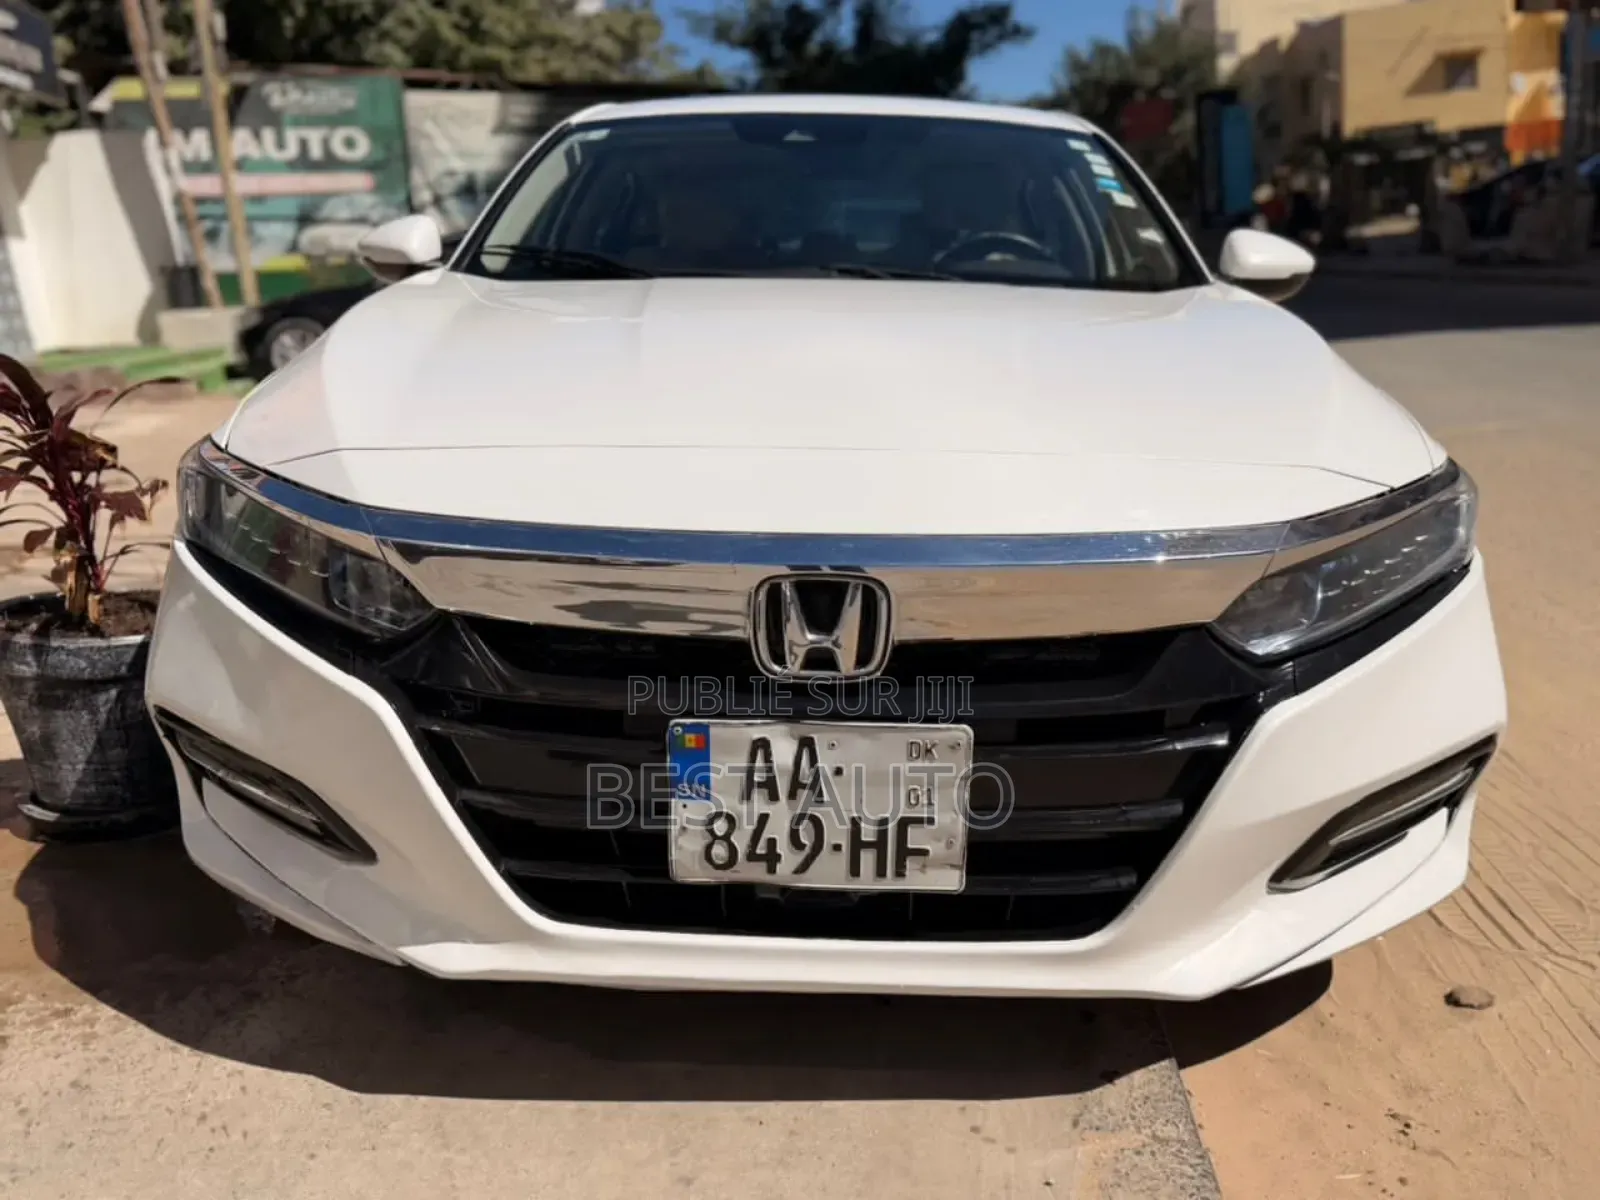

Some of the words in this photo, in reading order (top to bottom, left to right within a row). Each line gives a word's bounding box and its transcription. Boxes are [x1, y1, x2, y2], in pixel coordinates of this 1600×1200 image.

[233, 126, 371, 162] AUTO
[907, 740, 940, 761] DK
[907, 784, 936, 808] 01
